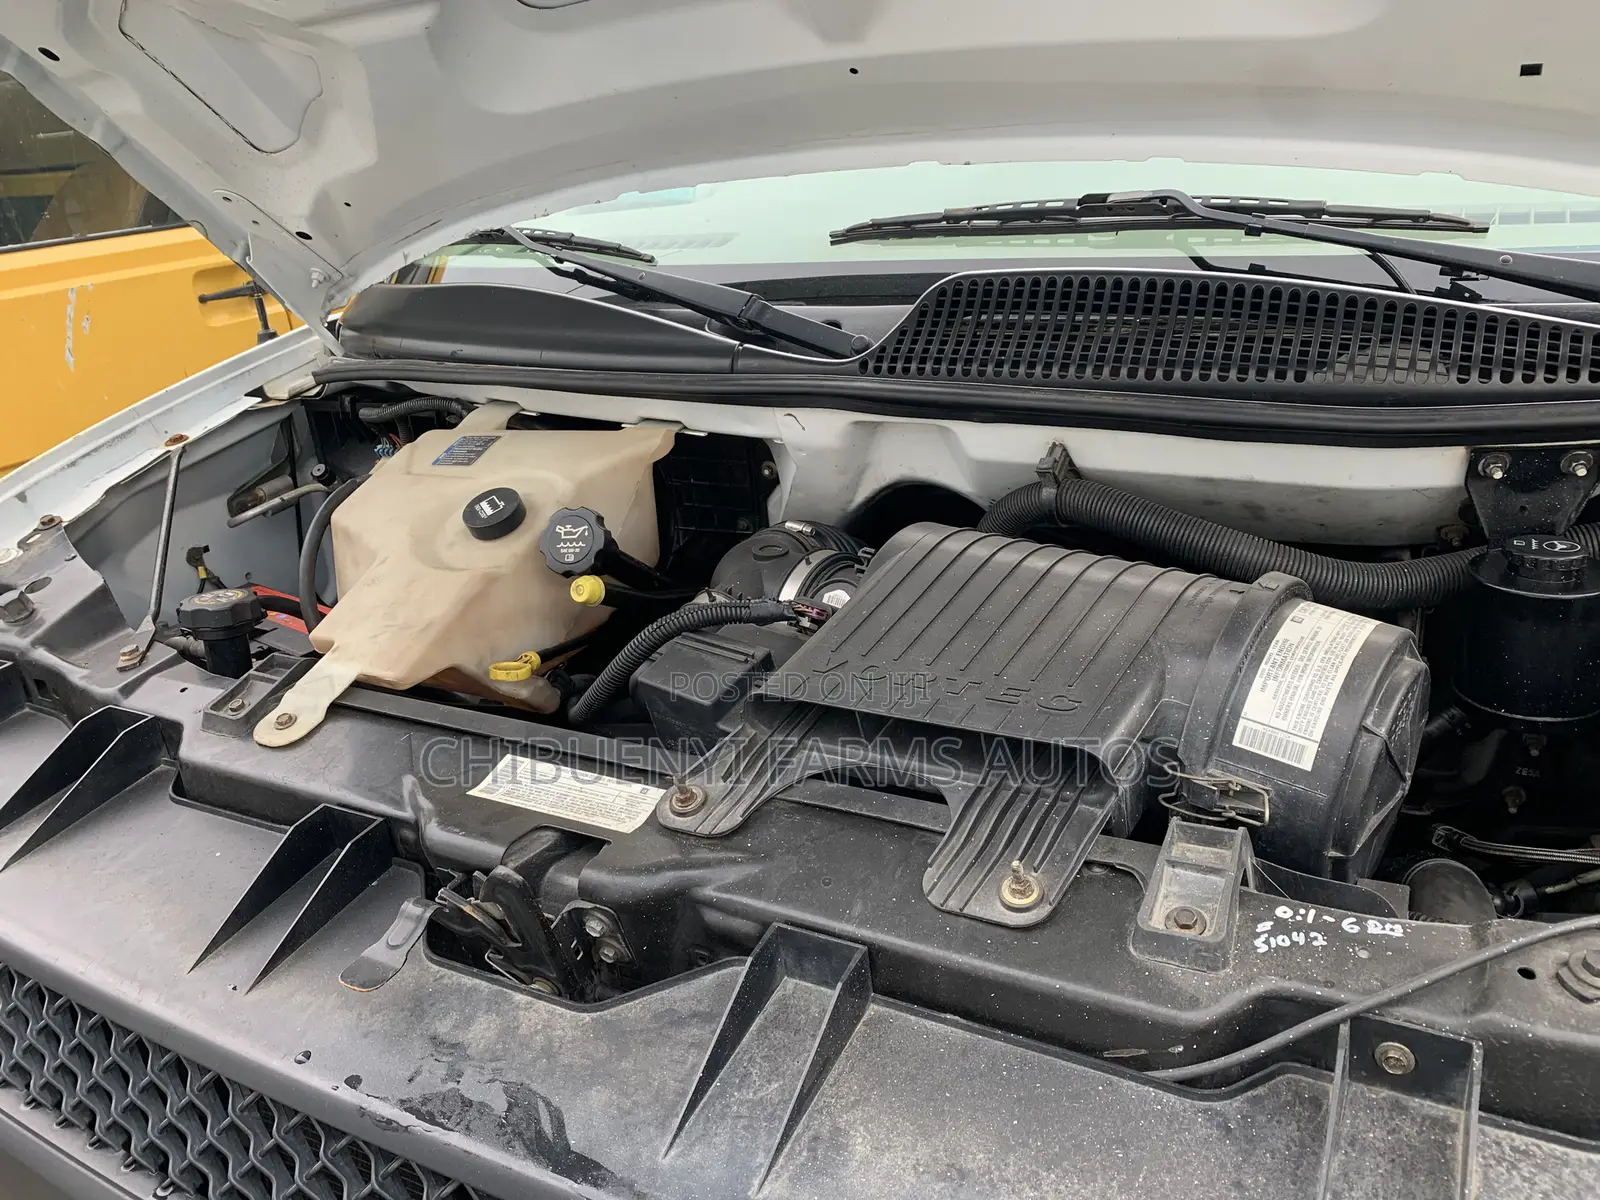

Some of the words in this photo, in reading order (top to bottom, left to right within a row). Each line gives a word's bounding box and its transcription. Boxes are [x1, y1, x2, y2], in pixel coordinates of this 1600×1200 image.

[1259, 657, 1280, 693] IMPORTANT
[1274, 637, 1290, 656] ENGINE
[1271, 642, 1295, 681] INFORMATION
